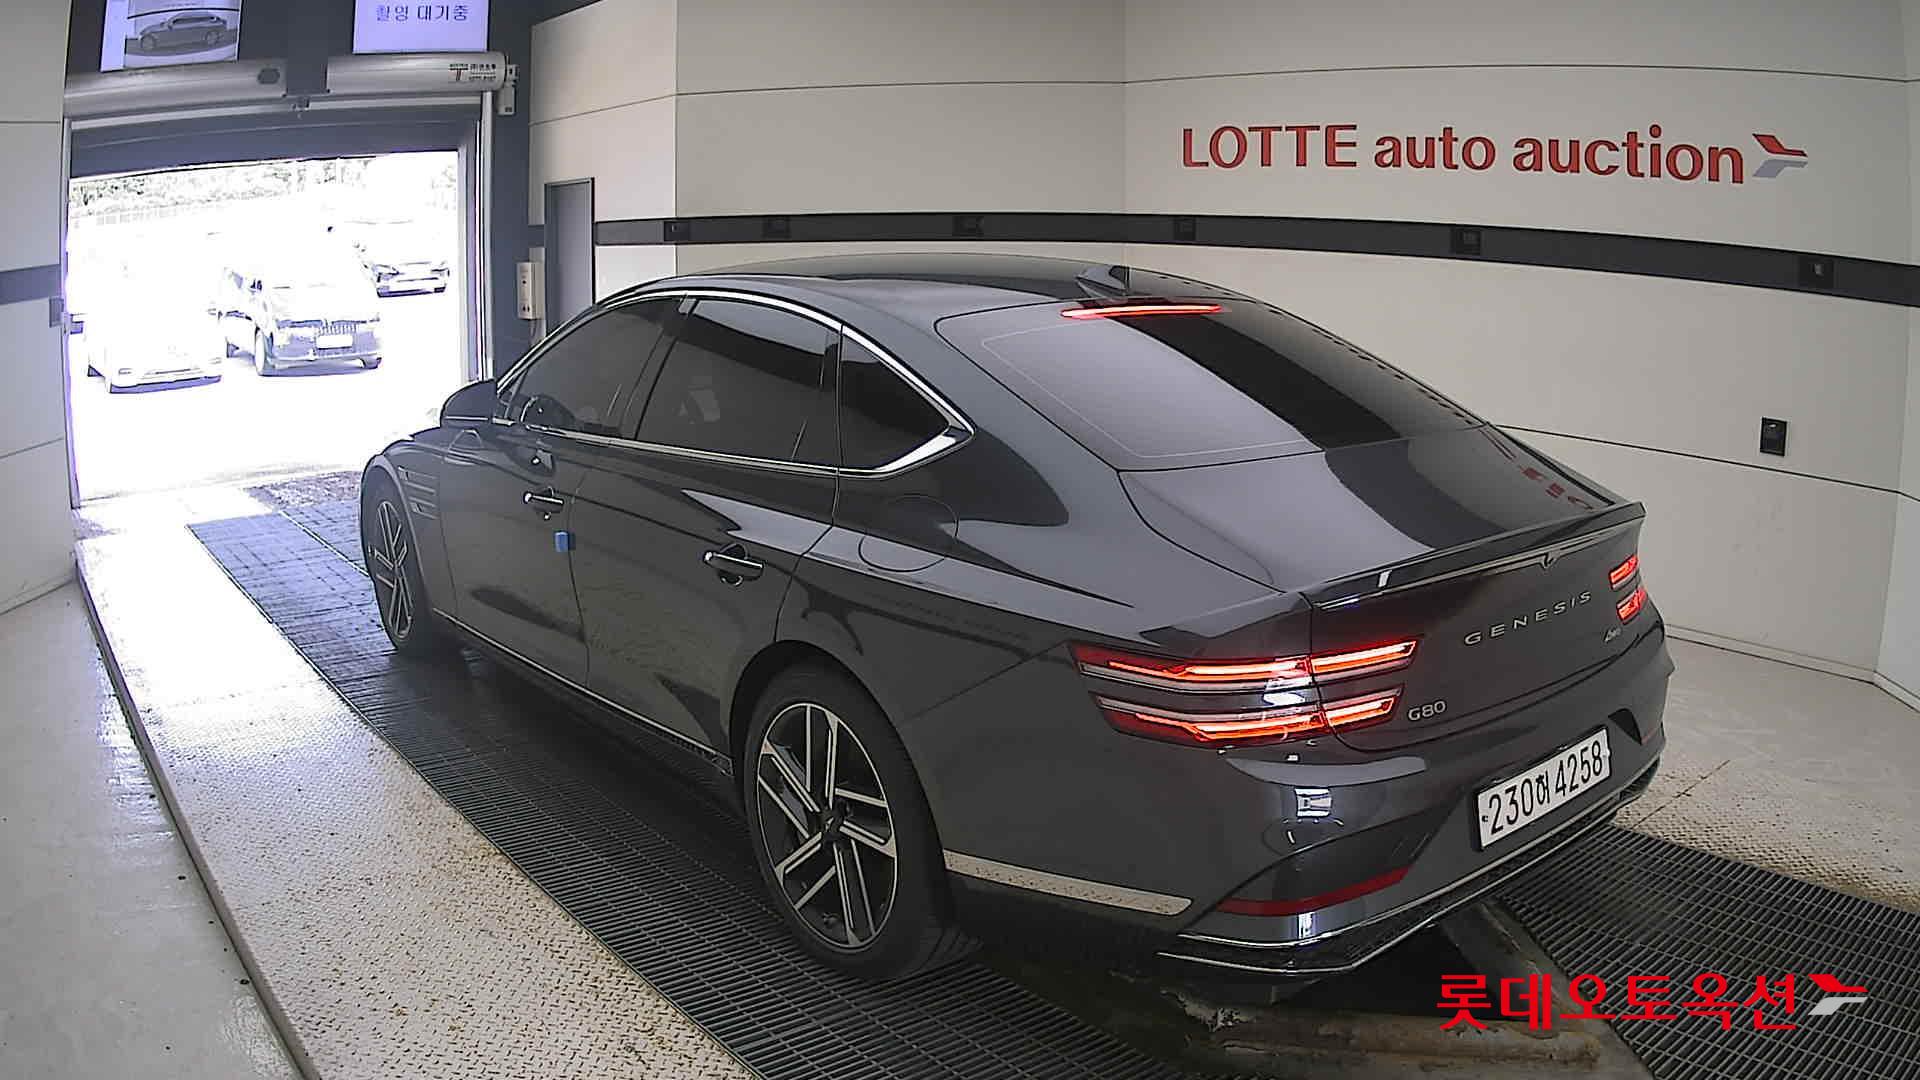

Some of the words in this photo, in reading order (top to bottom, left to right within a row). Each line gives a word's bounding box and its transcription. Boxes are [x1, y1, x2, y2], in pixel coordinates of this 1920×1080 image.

[417, 5, 468, 20] 대기중
[1183, 124, 1357, 168] LOTTE
[1375, 127, 1496, 170] auto
[1513, 124, 1745, 184] auction
[1464, 592, 1592, 645] GENESIS
[1408, 700, 1446, 721] G80
